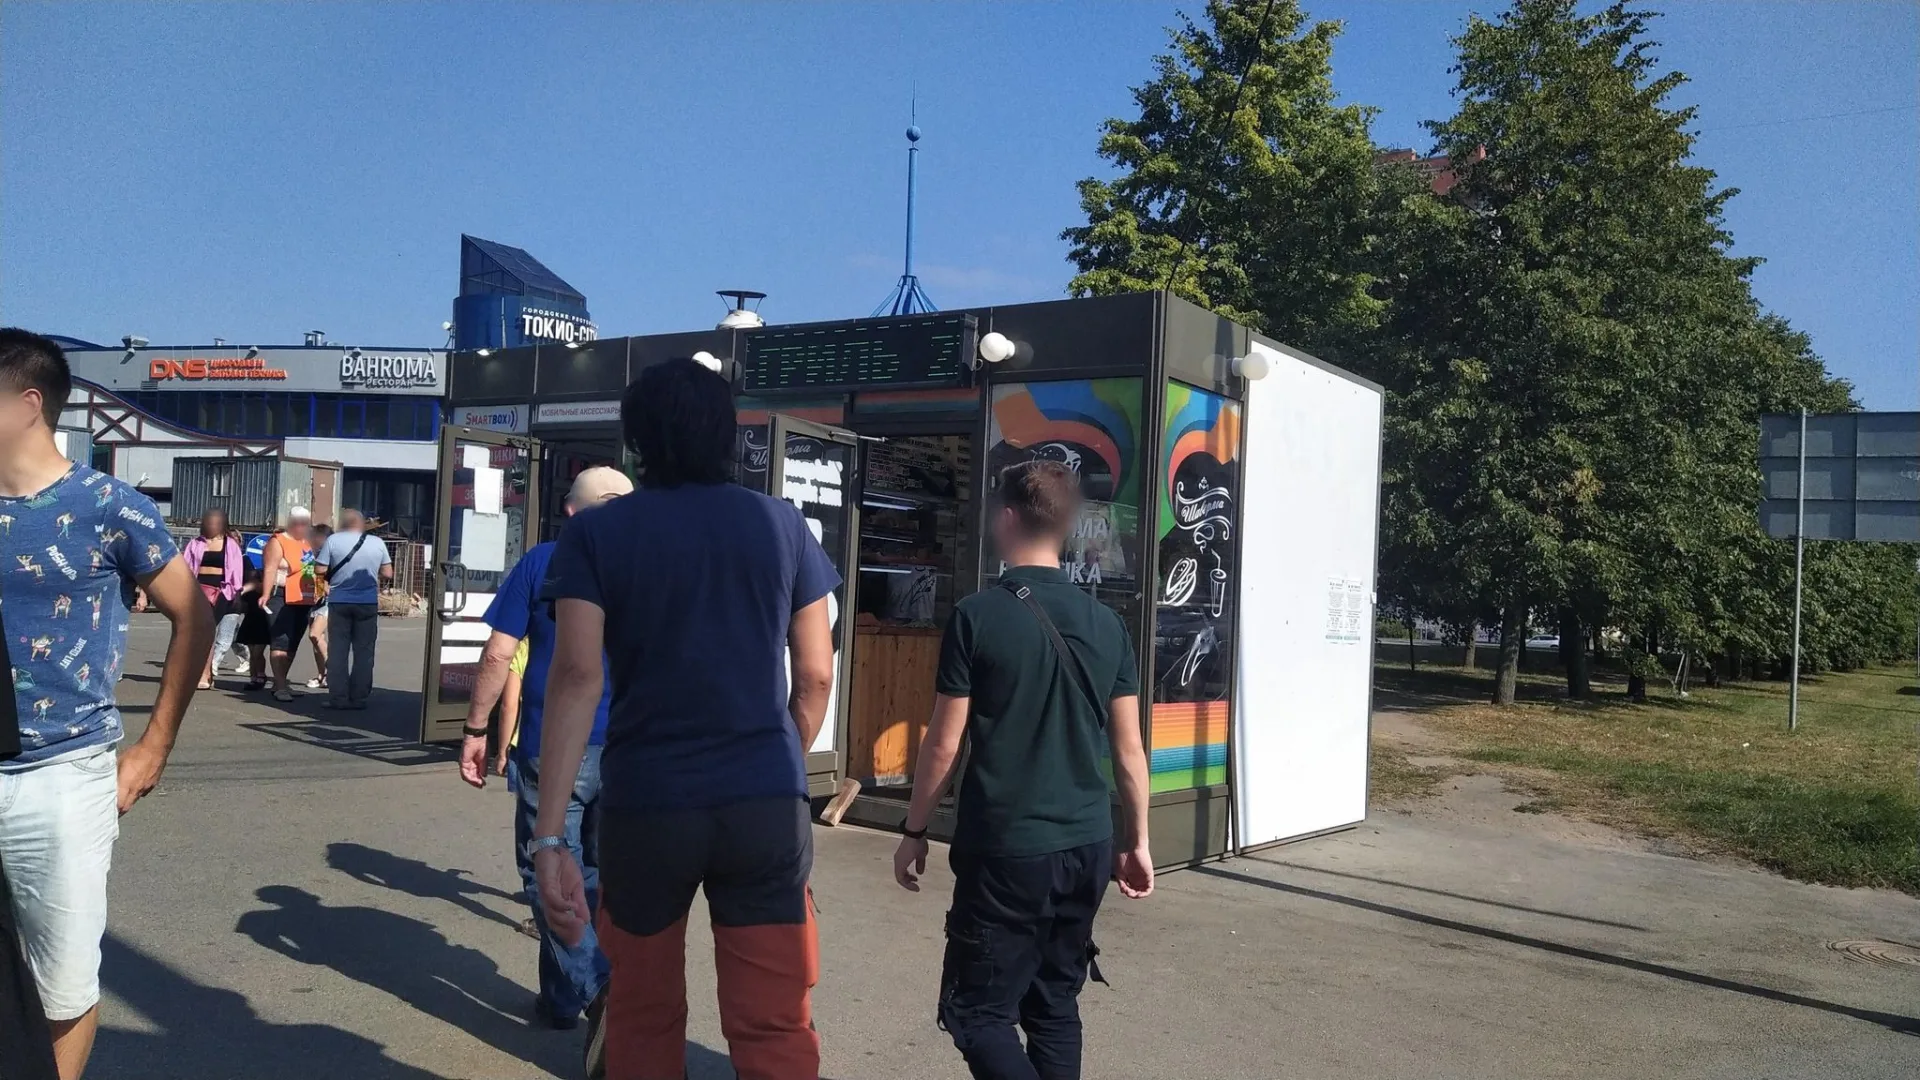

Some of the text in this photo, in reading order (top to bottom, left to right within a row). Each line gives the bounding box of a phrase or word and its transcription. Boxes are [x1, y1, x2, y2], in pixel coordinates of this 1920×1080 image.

[522, 307, 569, 320] ГОРОДСКИЕ
[150, 359, 208, 378] DNS
[341, 355, 437, 379] BAHROMA
[366, 378, 414, 388] РЕСТОРАН
[541, 408, 579, 417] МОБИЛЬНЫЕ
